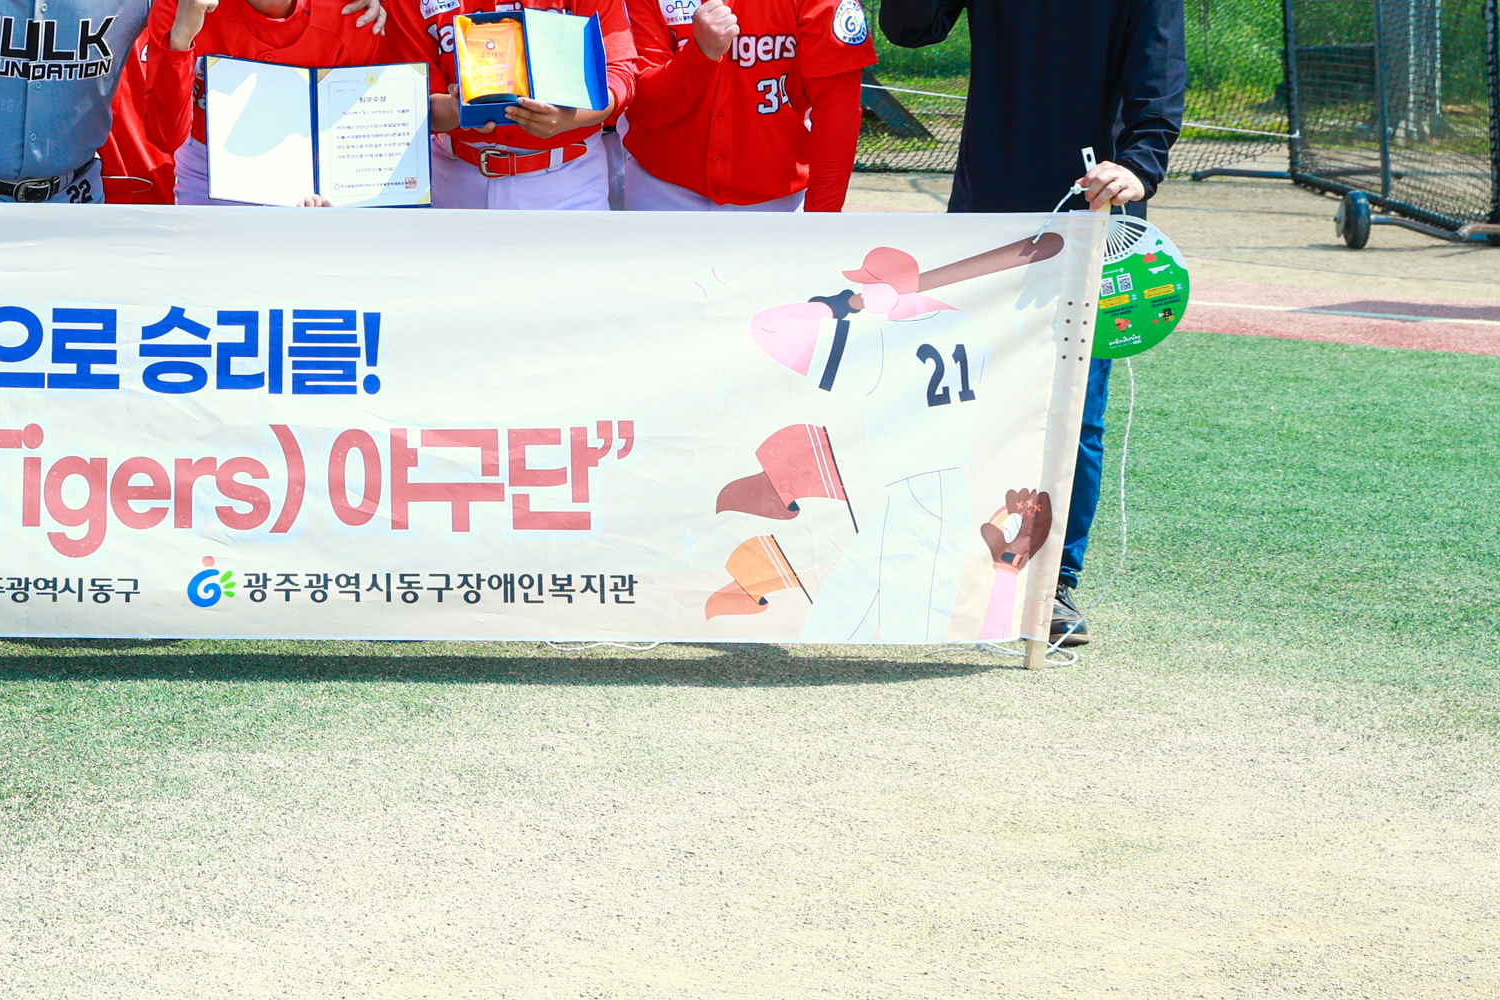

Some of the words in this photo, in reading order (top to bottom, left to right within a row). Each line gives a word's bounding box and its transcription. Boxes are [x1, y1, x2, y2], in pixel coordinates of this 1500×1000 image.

[730, 34, 797, 68] igers
[66, 178, 93, 203] 22
[139, 304, 383, 396] 승리를!
[915, 343, 976, 408] 21
[327, 420, 635, 533] 야구단”
[242, 571, 639, 605] 광주광역시동구장애인복지관
